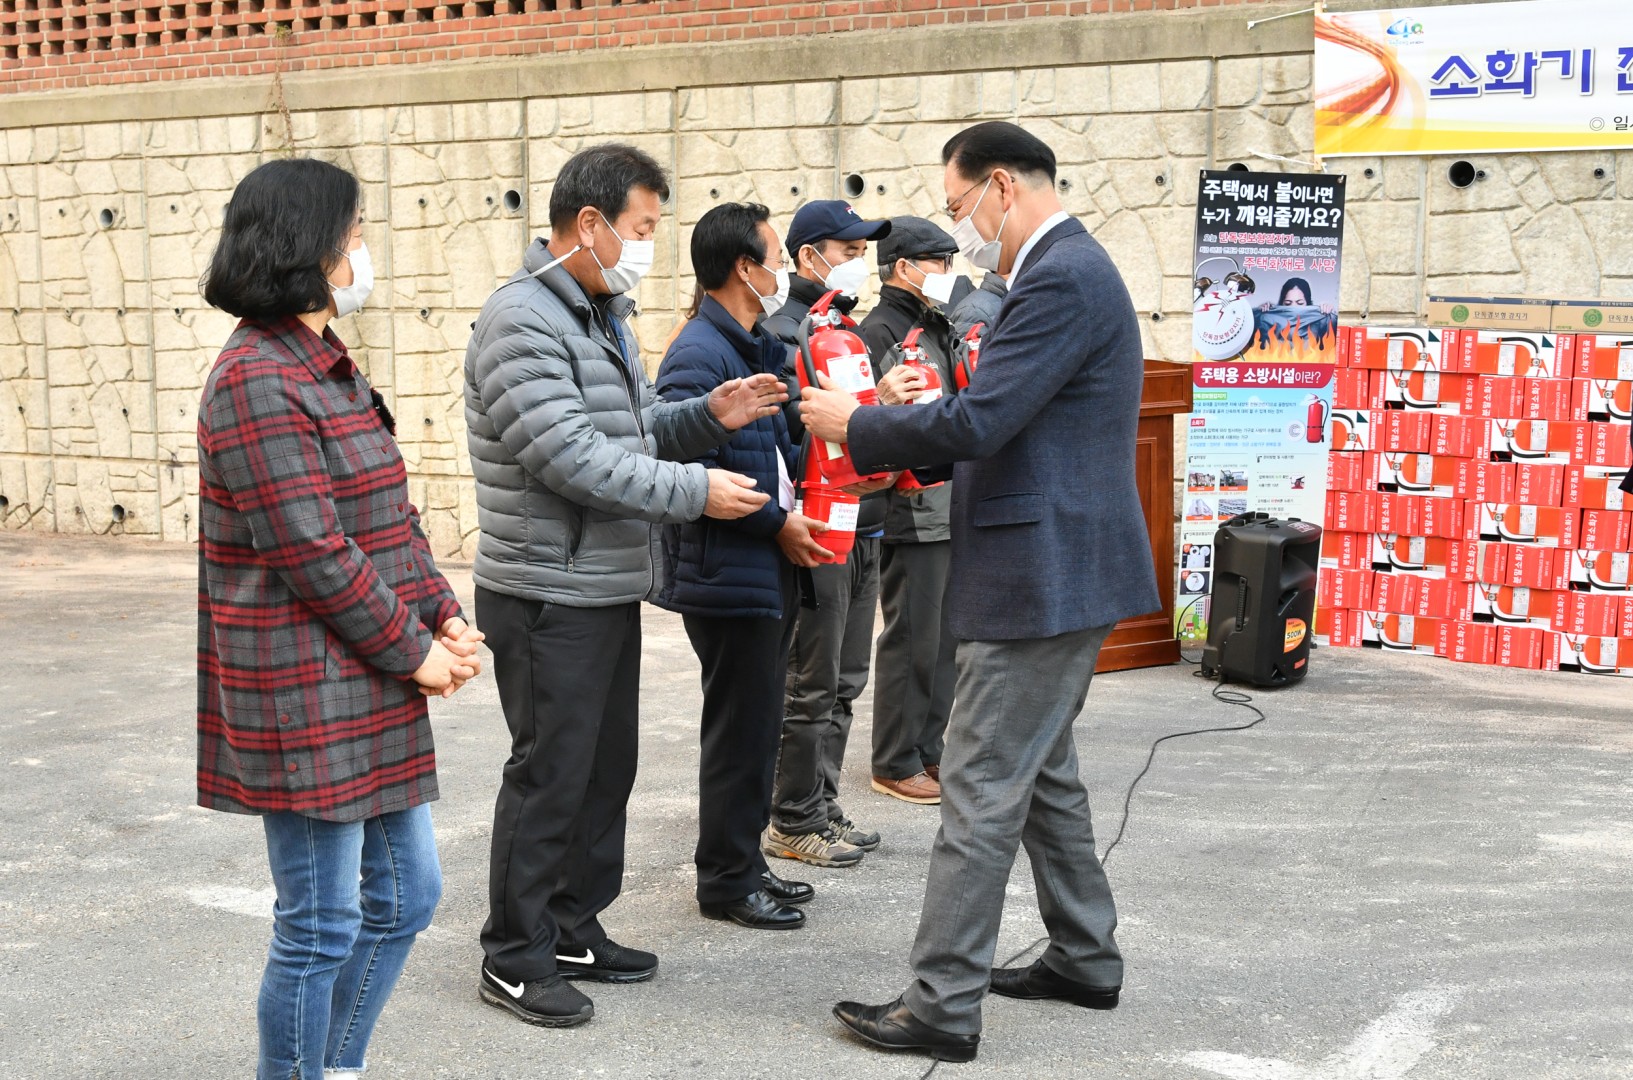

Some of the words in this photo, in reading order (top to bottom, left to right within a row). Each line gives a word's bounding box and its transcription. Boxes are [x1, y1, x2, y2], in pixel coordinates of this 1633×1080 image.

[1430, 49, 1592, 96] 소화기
[1614, 115, 1633, 131] 일
[1203, 180, 1269, 201] 주택에서
[1274, 181, 1333, 204] 불이나면
[1201, 208, 1231, 225] 누가
[1236, 205, 1342, 228] 깨워줄까요?
[1243, 256, 1305, 272] 주택화재로
[1310, 258, 1336, 273] 사망
[1354, 332, 1363, 363] 분말소화기
[1464, 335, 1473, 368] 분말소화기
[1581, 340, 1591, 373] 분말소화기
[1200, 366, 1240, 384] 주택용
[1243, 367, 1322, 384] 소방시설이란?
[1465, 378, 1474, 410] 분말소화기
[1482, 379, 1493, 416] 분말소화기
[1529, 380, 1541, 418] 분말소화기
[1390, 412, 1401, 449] 분말소화기
[1436, 416, 1448, 454] 분말소화기
[1575, 427, 1584, 459] 분말소화기
[1595, 425, 1608, 463] 분말소화기
[1458, 462, 1467, 494] 분말소화기
[1476, 463, 1486, 501] 분말소화기
[1519, 465, 1532, 503] 분말소화기
[1569, 470, 1579, 503] 분말소화기
[1338, 492, 1348, 529] 분말소화기
[1381, 494, 1390, 531] 분말소화기
[1424, 497, 1433, 535] 분말소화기
[1563, 513, 1573, 545] 분말소화기
[1585, 511, 1599, 549] 분말소화기
[1343, 535, 1351, 566] 분말소화기
[1451, 542, 1459, 573] 분말소화기
[1465, 543, 1477, 580] 분말소화기
[1513, 545, 1525, 584] 분말소화기
[1334, 570, 1344, 606] 분말소화기
[1377, 576, 1390, 611] 분말소화기
[1419, 579, 1431, 616] 분말소화기
[1334, 612, 1342, 642] 분말소화기
[1555, 594, 1565, 627] 분말소화기
[1574, 594, 1587, 633] 분말소화기
[1286, 629, 1302, 639] 500W
[1439, 624, 1448, 654] 분말소화기
[1455, 623, 1466, 660] 분말소화기
[1501, 627, 1512, 665] 분말소화기
